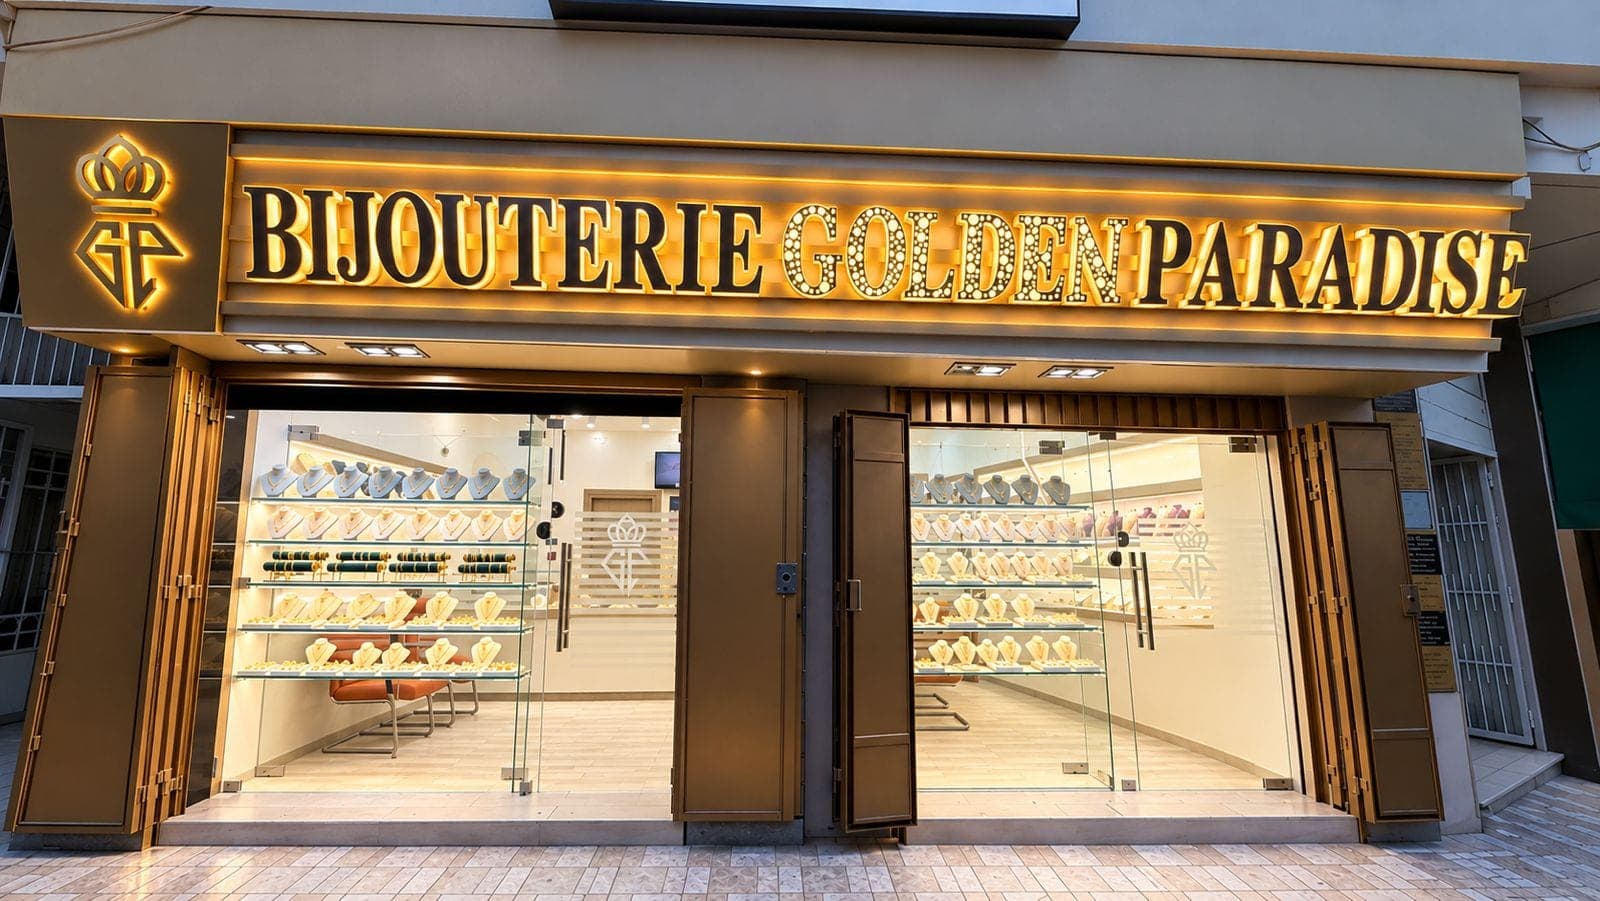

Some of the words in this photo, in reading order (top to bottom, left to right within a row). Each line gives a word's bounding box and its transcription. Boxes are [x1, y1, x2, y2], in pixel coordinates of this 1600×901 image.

[244, 186, 763, 296] BIJOUTERIE
[782, 204, 1128, 305] GOLDEN
[1136, 217, 1530, 317] PARADISE
